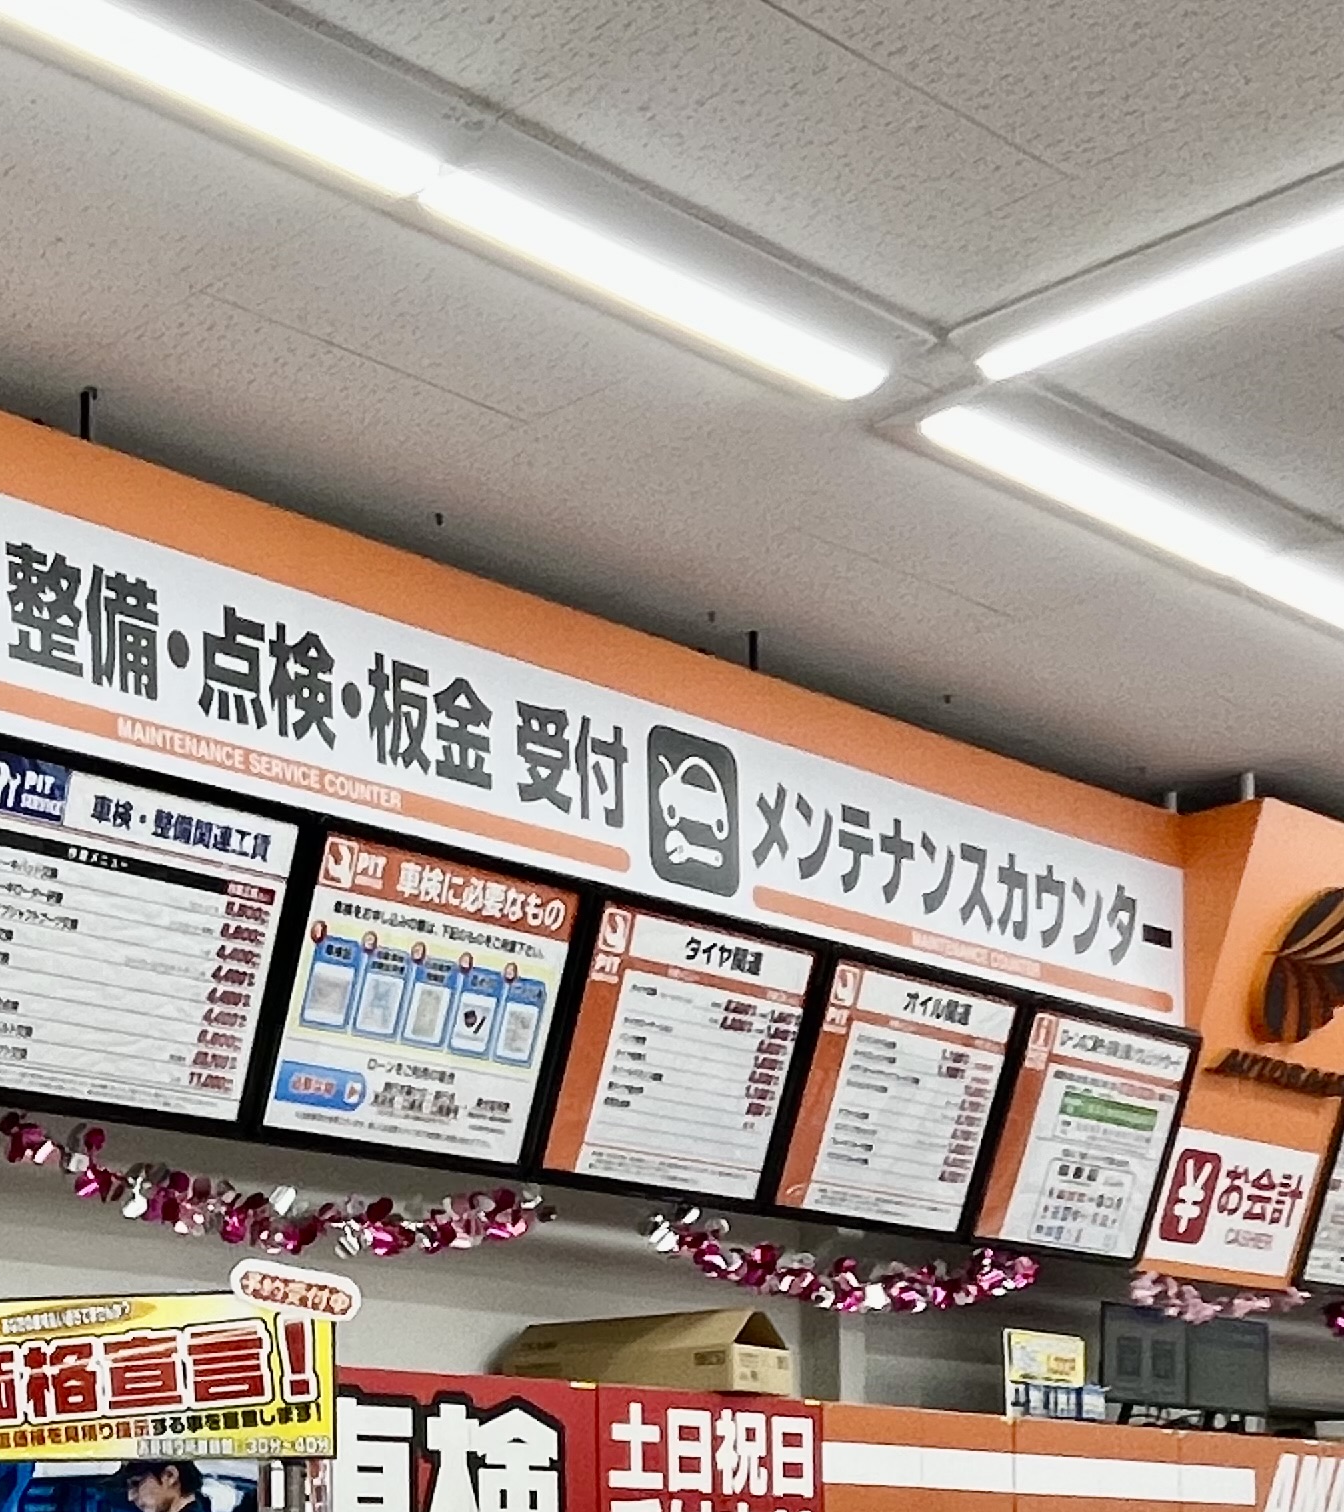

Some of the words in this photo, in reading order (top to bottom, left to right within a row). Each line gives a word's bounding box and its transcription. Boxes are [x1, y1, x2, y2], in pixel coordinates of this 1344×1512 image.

[24, 770, 56, 795] PIT
[116, 716, 246, 768] MAINTENANCE
[247, 746, 324, 792] SERVICE
[323, 771, 403, 809] COUNTER
[515, 700, 628, 828] 受付
[357, 851, 388, 879] PIT
[397, 862, 565, 931] 車検に必要なもの
[752, 782, 1175, 966] メンテナンスカウンター
[1217, 1165, 1303, 1228] お会計
[608, 1402, 815, 1499] 土日祝日
